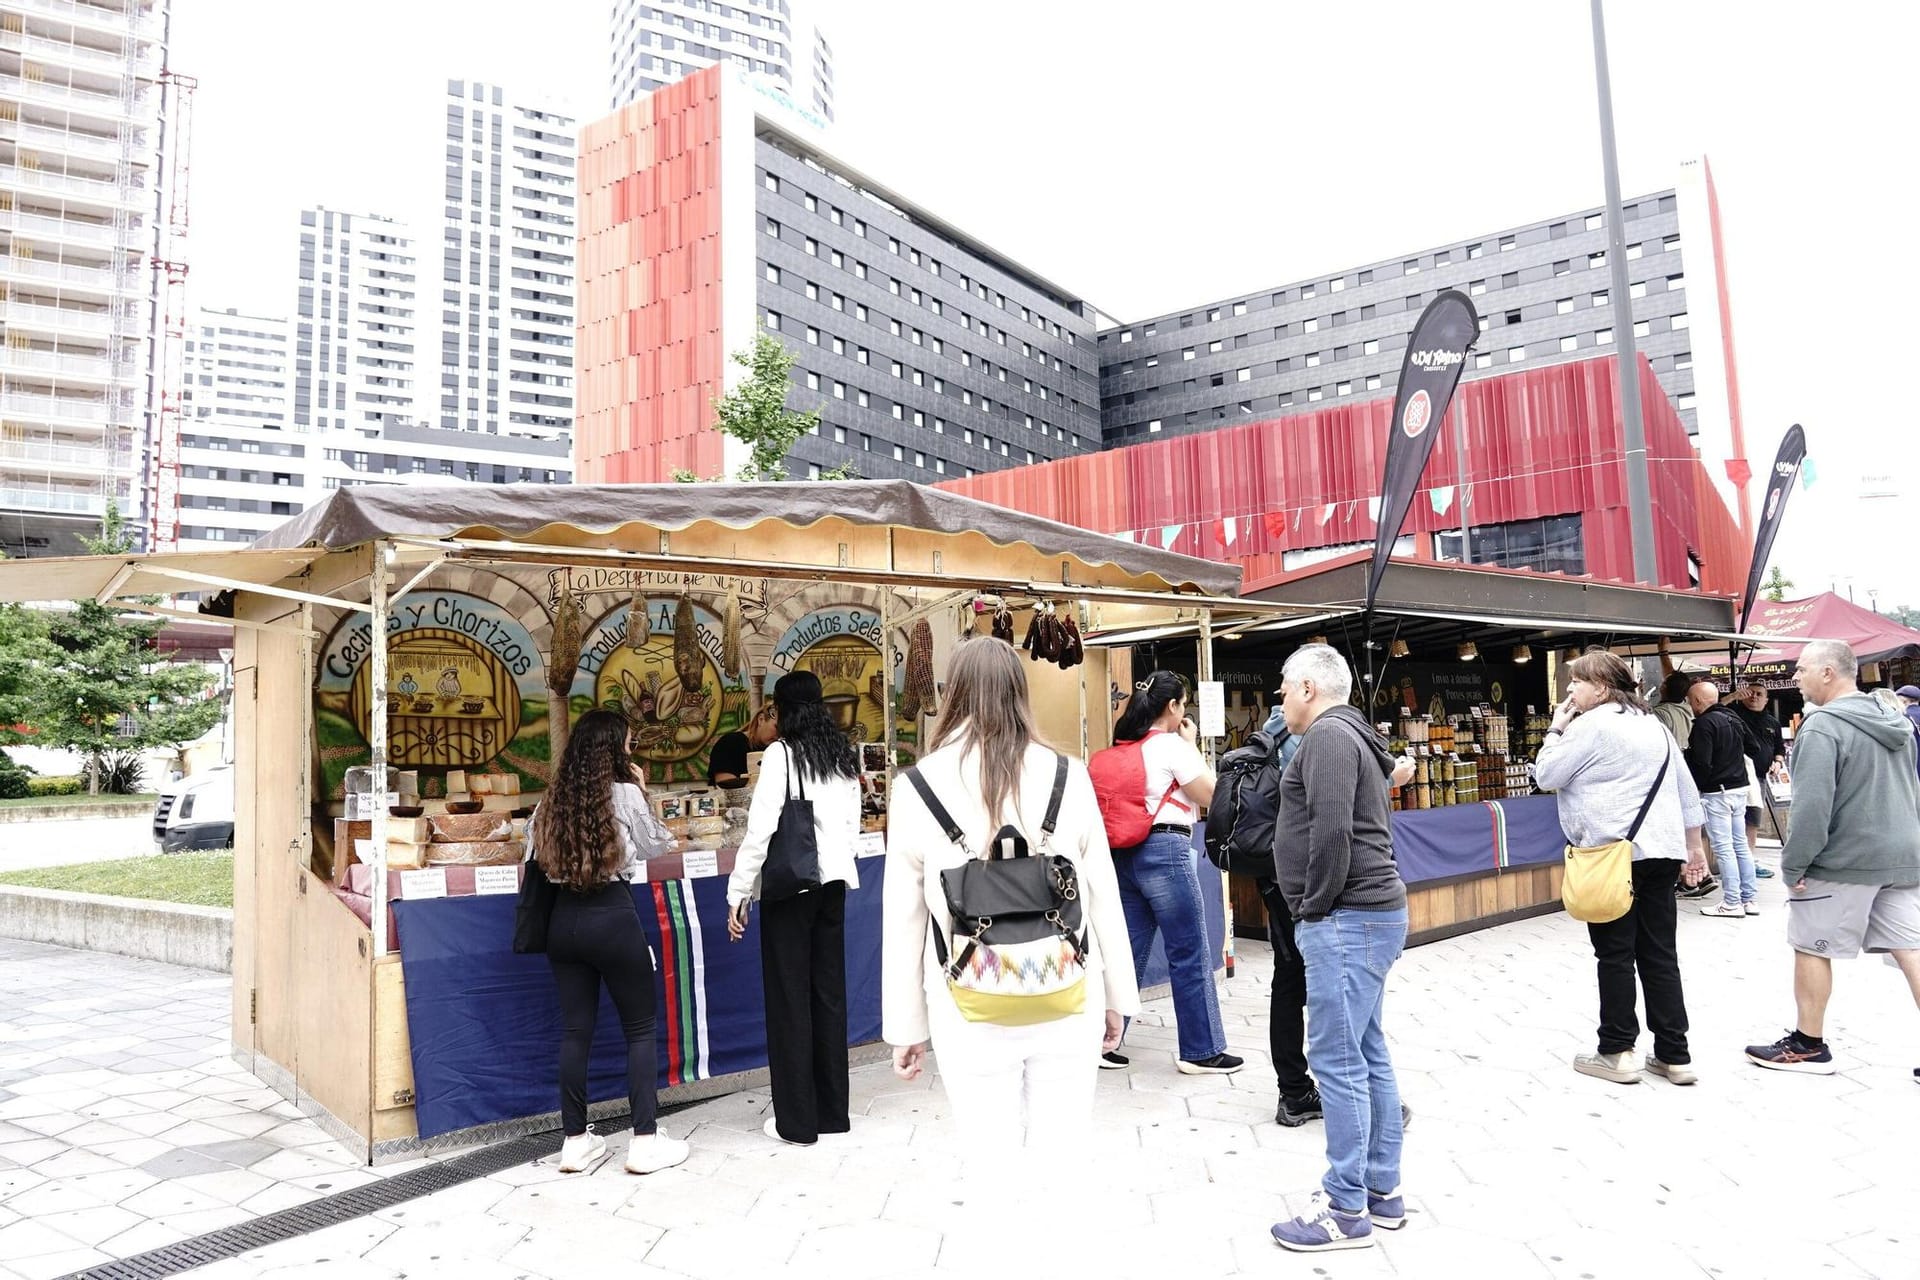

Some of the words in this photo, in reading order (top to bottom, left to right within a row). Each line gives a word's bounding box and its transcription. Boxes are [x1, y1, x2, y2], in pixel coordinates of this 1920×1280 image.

[568, 568, 590, 590] La
[326, 611, 402, 679] Cecins
[432, 597, 532, 677] Chorizos
[773, 615, 842, 672] Productos
